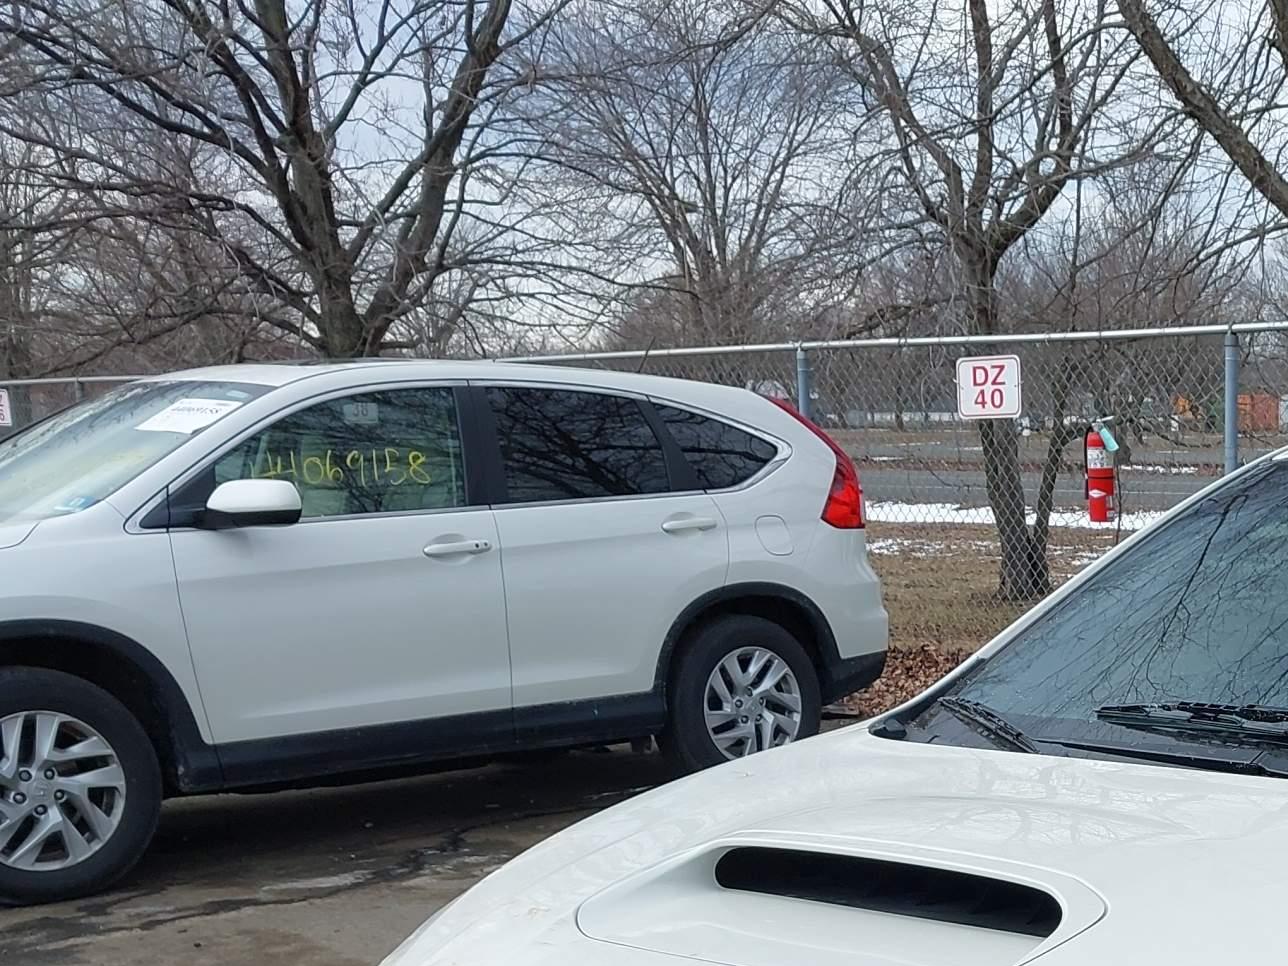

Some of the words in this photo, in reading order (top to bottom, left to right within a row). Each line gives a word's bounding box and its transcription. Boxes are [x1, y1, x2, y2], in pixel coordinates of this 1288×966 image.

[972, 364, 1006, 387] DZ
[974, 389, 1004, 409] 40
[249, 448, 431, 488] 44069158
